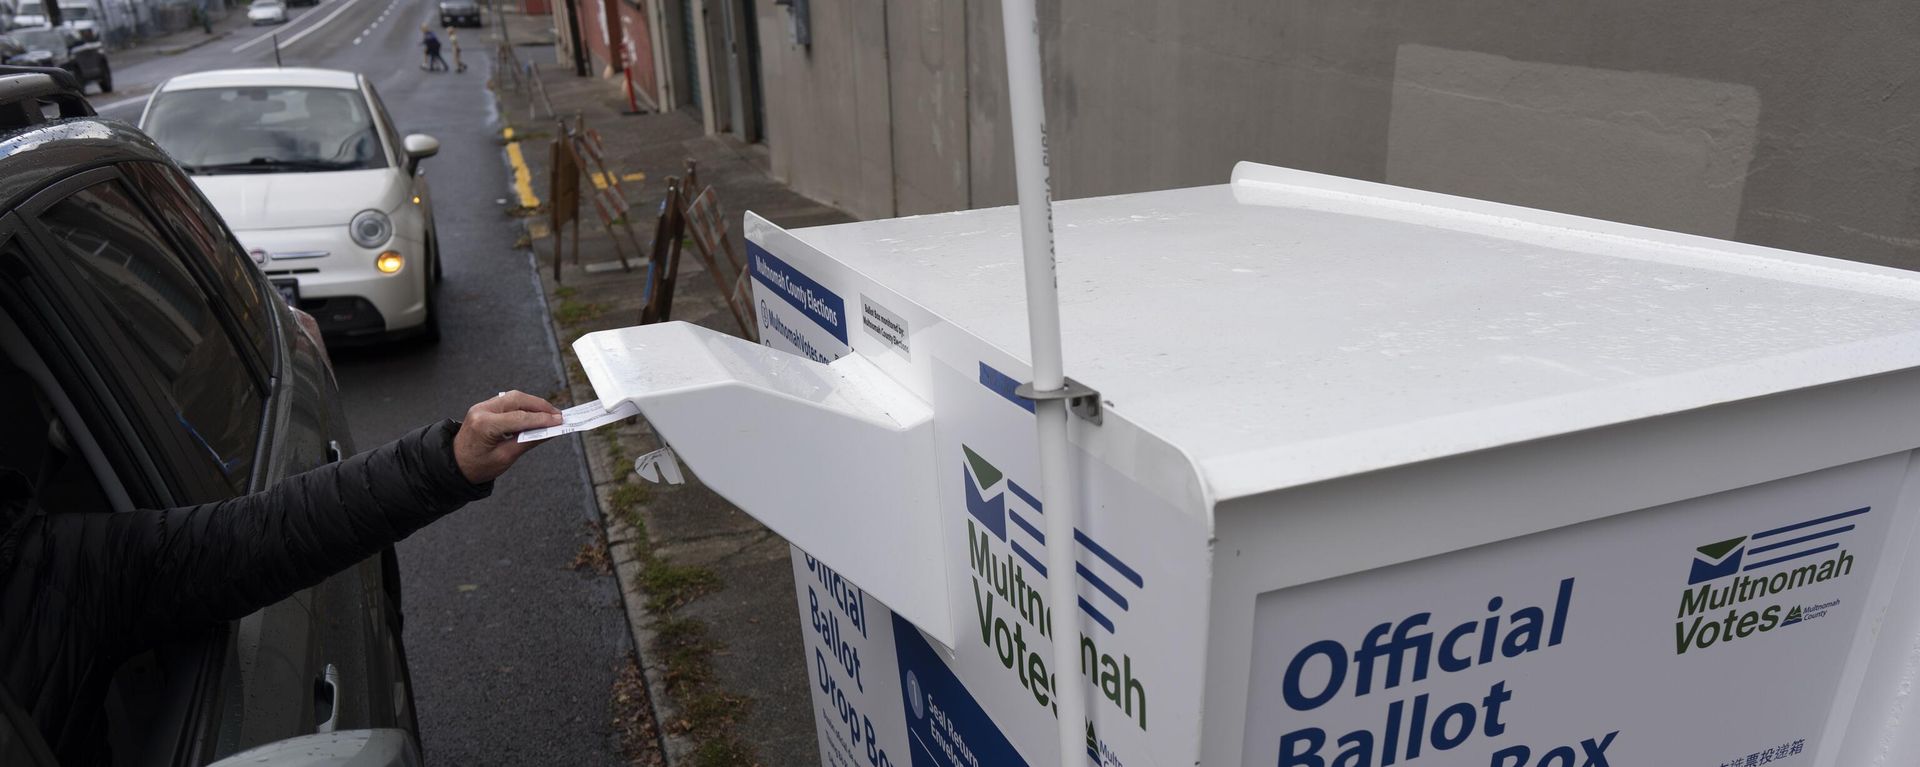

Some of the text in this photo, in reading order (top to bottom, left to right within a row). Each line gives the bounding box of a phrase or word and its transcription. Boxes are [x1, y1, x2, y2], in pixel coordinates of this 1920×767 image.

[755, 255, 838, 327] Multnomah County Elections
[881, 327, 894, 345] County
[893, 334, 910, 353] Elections
[1677, 549, 1854, 619] Multnomah
[1803, 599, 1841, 614] Multnomah
[1803, 608, 1828, 621] County
[808, 583, 864, 695] Ballot
[967, 518, 1147, 732] Multnmah
[972, 574, 1059, 721] Vote
[1282, 576, 1575, 711] Official
[1675, 604, 1781, 655] Votes
[815, 646, 861, 747] Drop
[928, 693, 979, 767] Seal Return
[1278, 680, 1513, 767] Ballot
